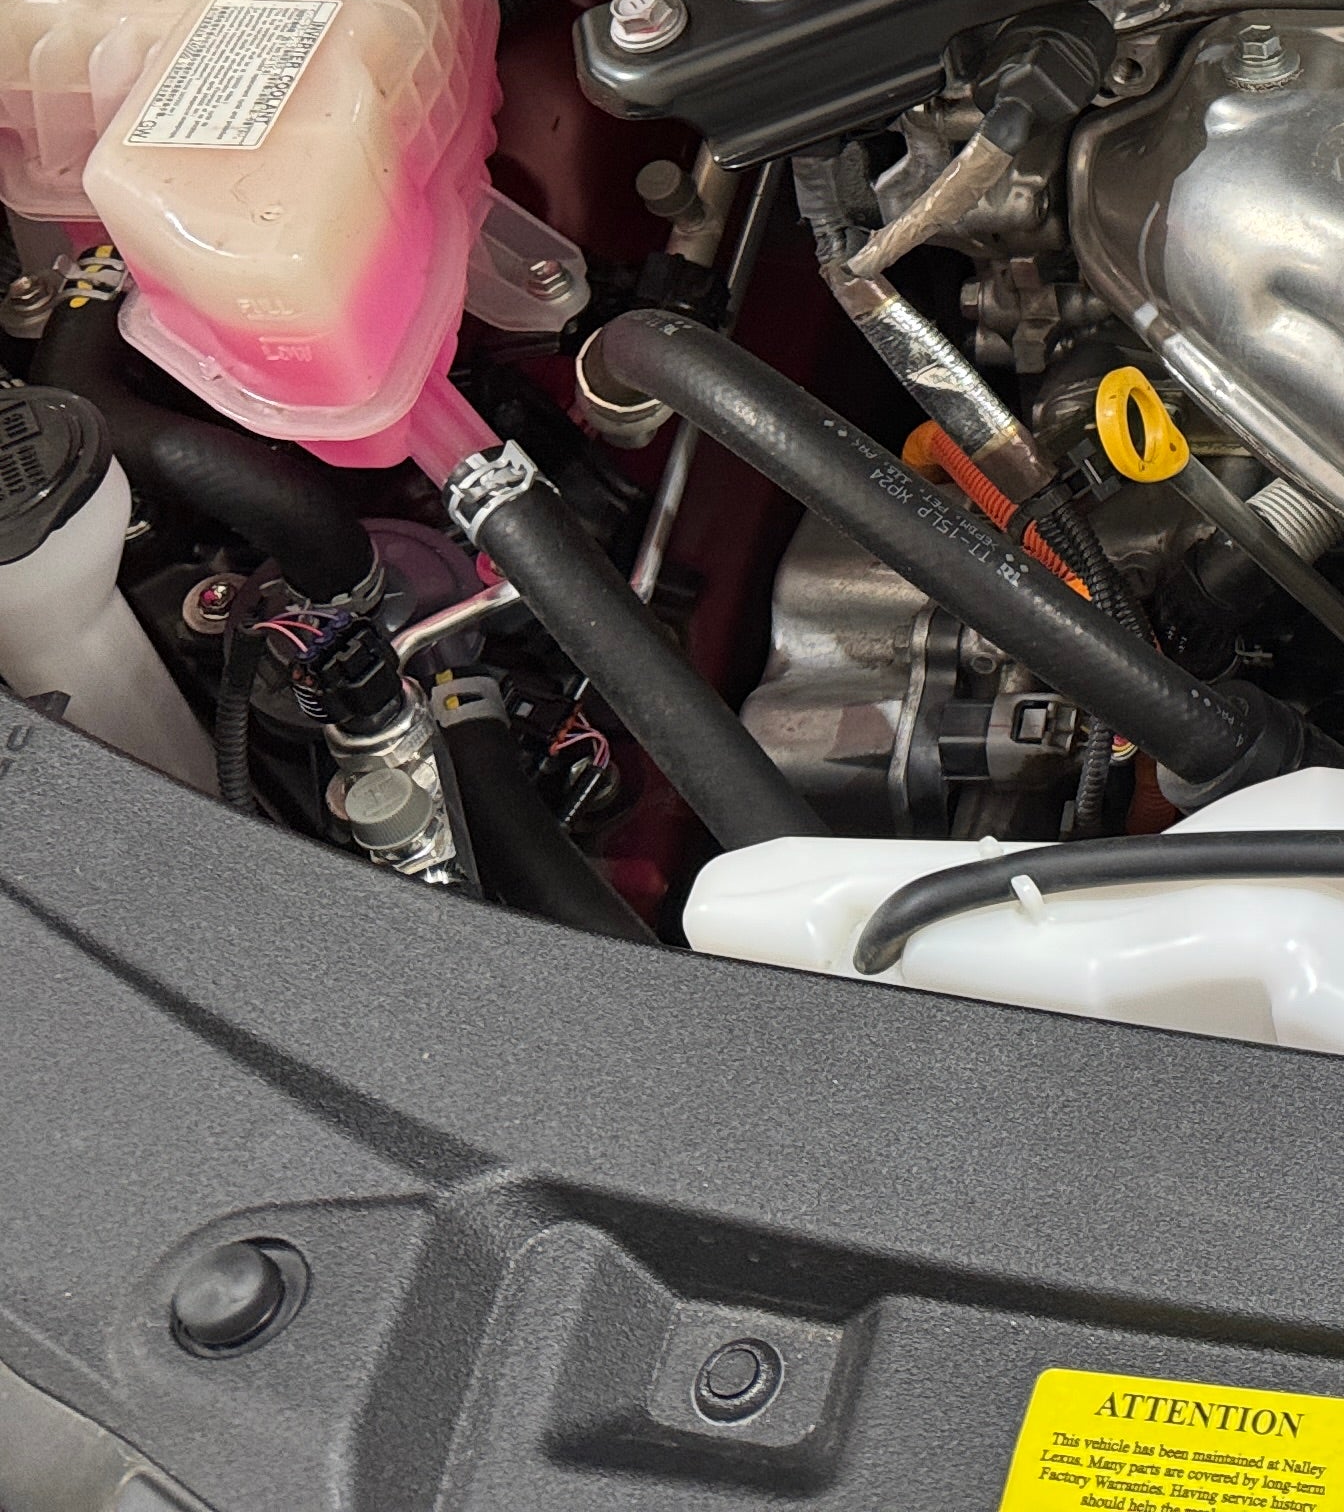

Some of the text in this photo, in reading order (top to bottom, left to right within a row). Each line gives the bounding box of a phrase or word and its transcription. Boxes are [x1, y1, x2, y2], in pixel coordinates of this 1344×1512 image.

[255, 74, 294, 126] COOLANT
[1094, 1391, 1306, 1439] ATTENTION
[1052, 1431, 1328, 1479] This vehicle has been maintained at Nalley
[1086, 1454, 1127, 1475] Many
[1126, 1462, 1162, 1477] parts
[1163, 1467, 1185, 1479] are
[1187, 1470, 1241, 1486] covered
[1241, 1473, 1261, 1490] by
[1261, 1475, 1326, 1496] long-term
[1038, 1466, 1317, 1512] Factory Warranties. Having service history
[1079, 1492, 1127, 1512] should
[1126, 1497, 1158, 1512] help
